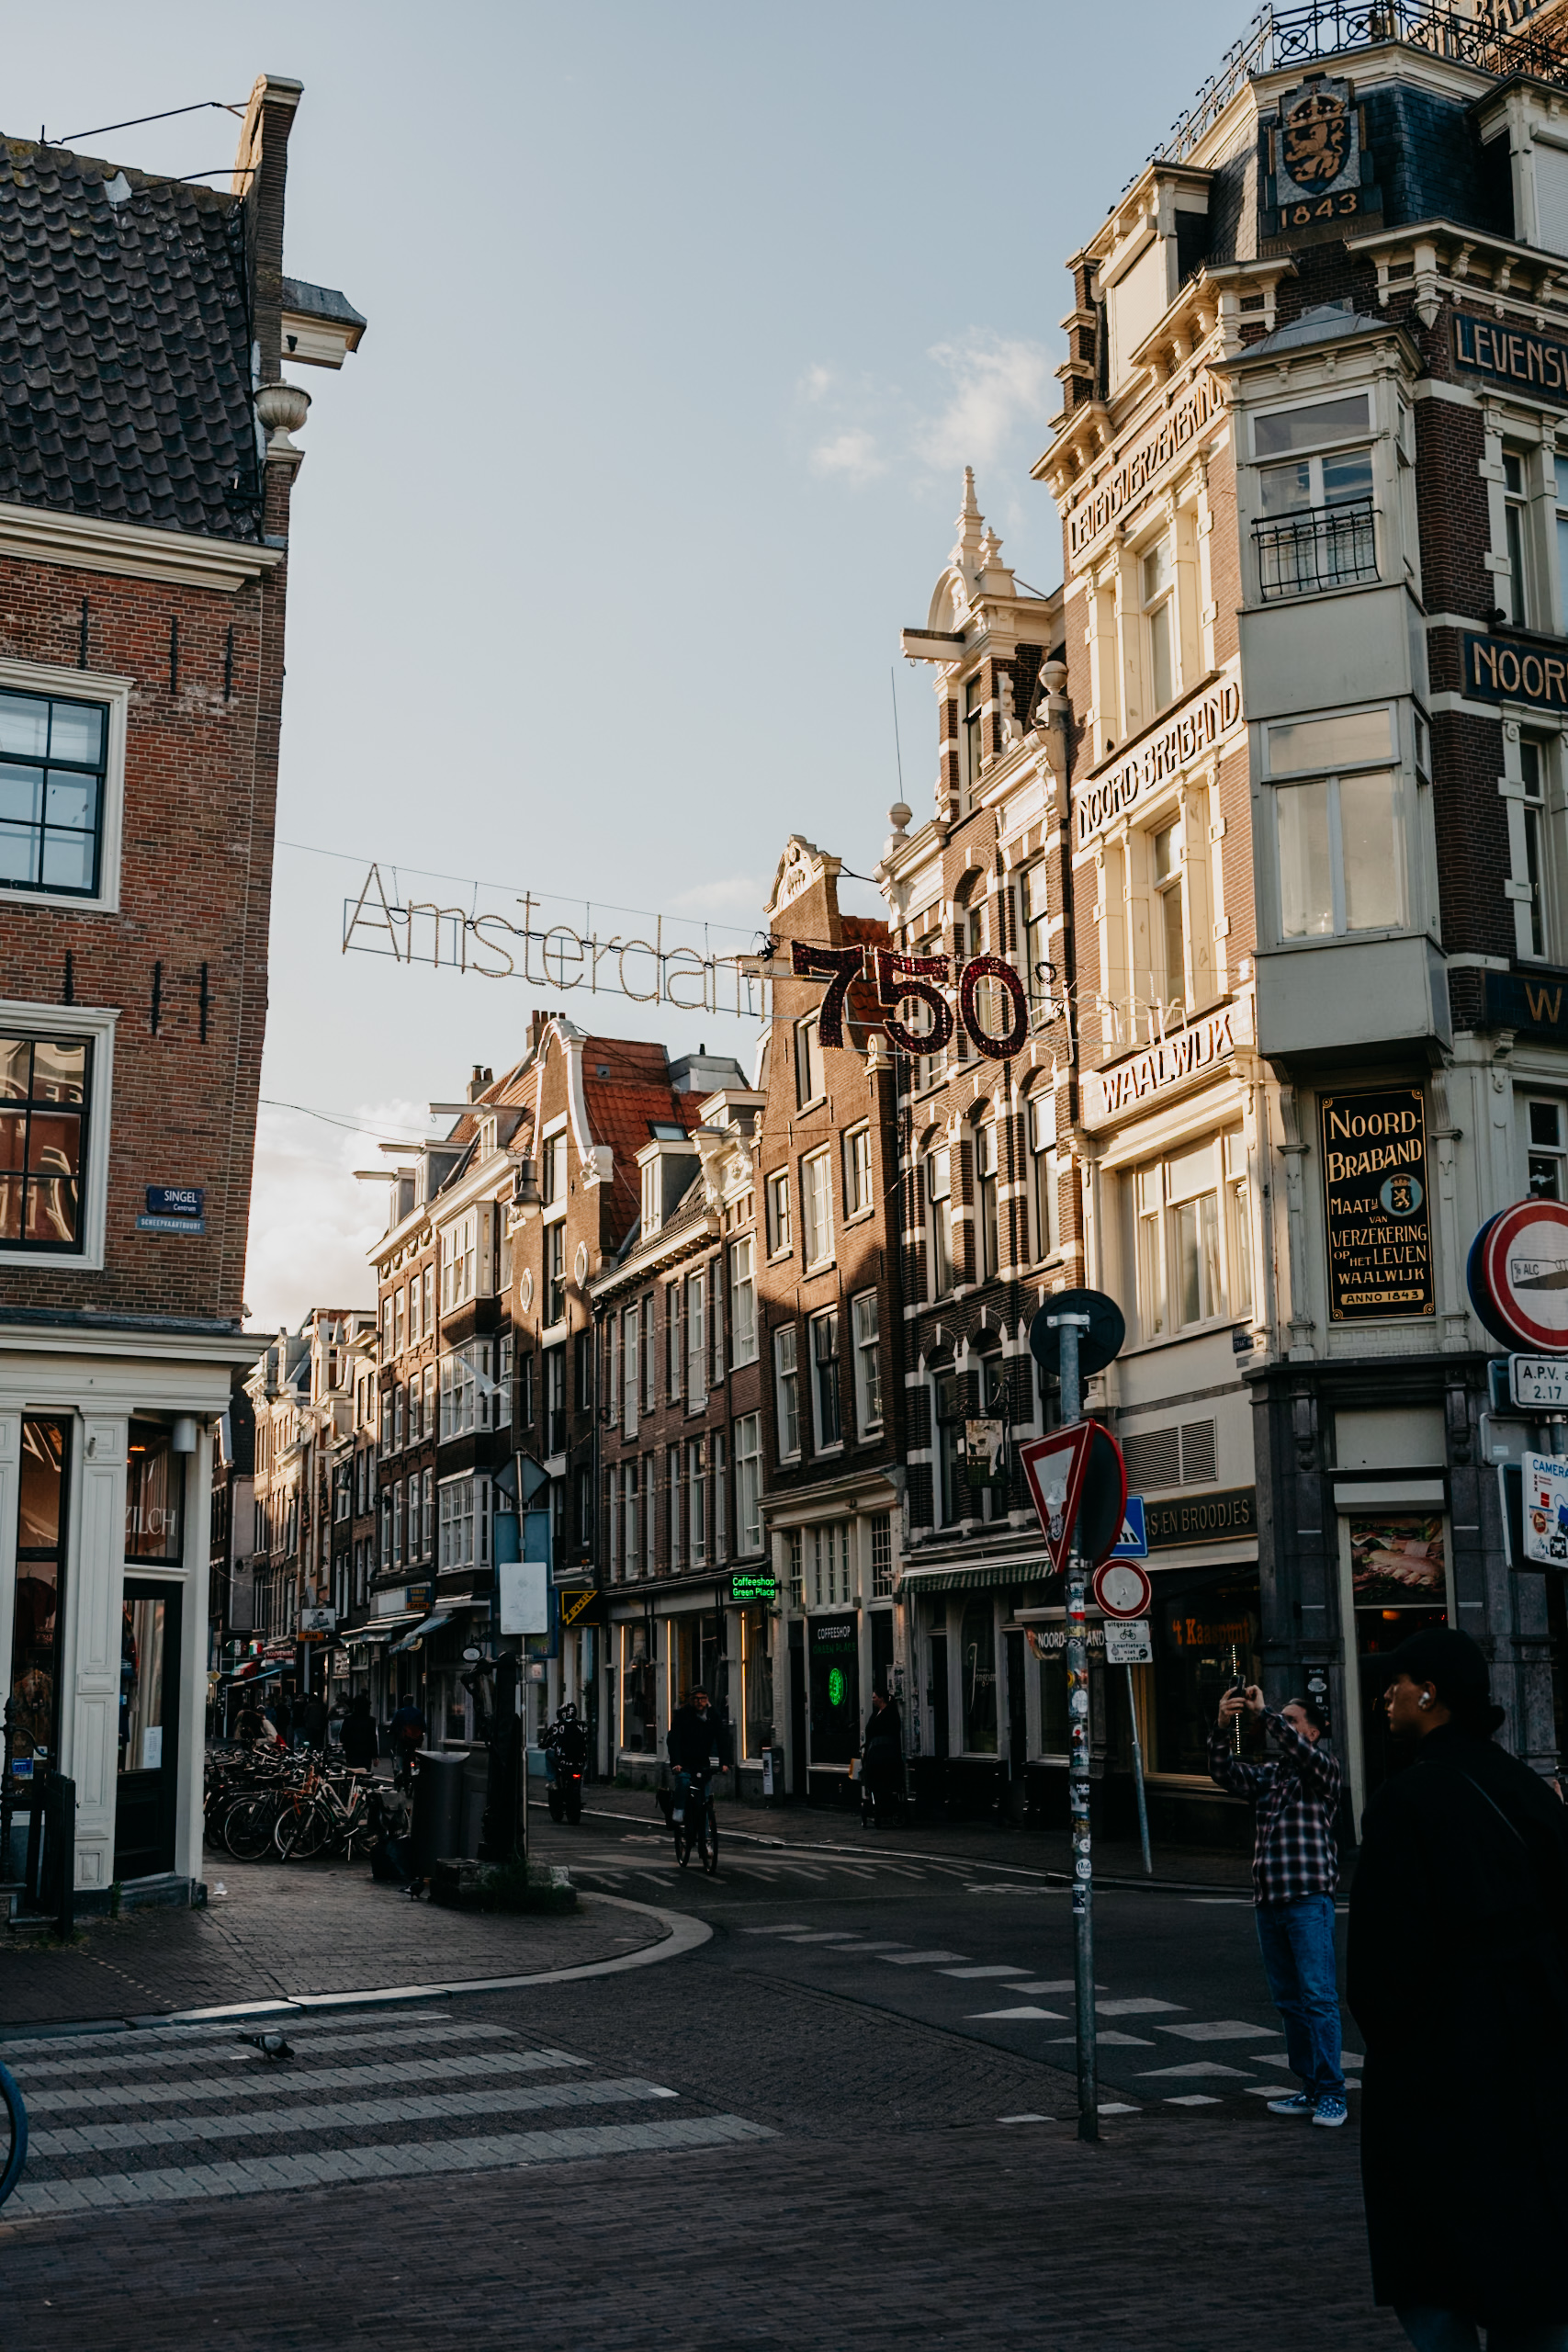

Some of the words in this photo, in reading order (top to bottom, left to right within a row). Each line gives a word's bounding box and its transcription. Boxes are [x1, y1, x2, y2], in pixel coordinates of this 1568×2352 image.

[1280, 193, 1358, 229] 1843
[1472, 641, 1568, 704] NOOR
[342, 863, 765, 1024] Amsterdam
[789, 939, 1029, 1060] 750
[1329, 1109, 1422, 1140] NOORD-
[1327, 1138, 1423, 1183] BRABAND
[164, 1190, 197, 1204] SINGEL
[173, 1204, 197, 1212] Centrum
[141, 1218, 201, 1230] SCHEEPVAARTBUURT
[1369, 1215, 1388, 1224] VAN
[1331, 1224, 1427, 1248] VERZEKERING
[1333, 1250, 1350, 1261] OP
[1349, 1256, 1371, 1267] HET
[1373, 1244, 1427, 1265] LEVEN
[1337, 1268, 1425, 1285] WAALWIJK
[1524, 1263, 1540, 1276] ALC
[1346, 1293, 1382, 1304] ANNO
[1387, 1290, 1419, 1301] 1843
[1523, 1365, 1559, 1380] A.P.V.
[1533, 1385, 1562, 1399] 2.17
[125, 1506, 176, 1537] ZILCH
[1181, 1498, 1250, 1532] BROODJES
[732, 1577, 775, 1589] Coffeeshop
[732, 1587, 754, 1597] Green
[755, 1587, 775, 1597] Place
[818, 1625, 851, 1640] COFFEESHOP
[1185, 1617, 1250, 1645] Kaaspunt
